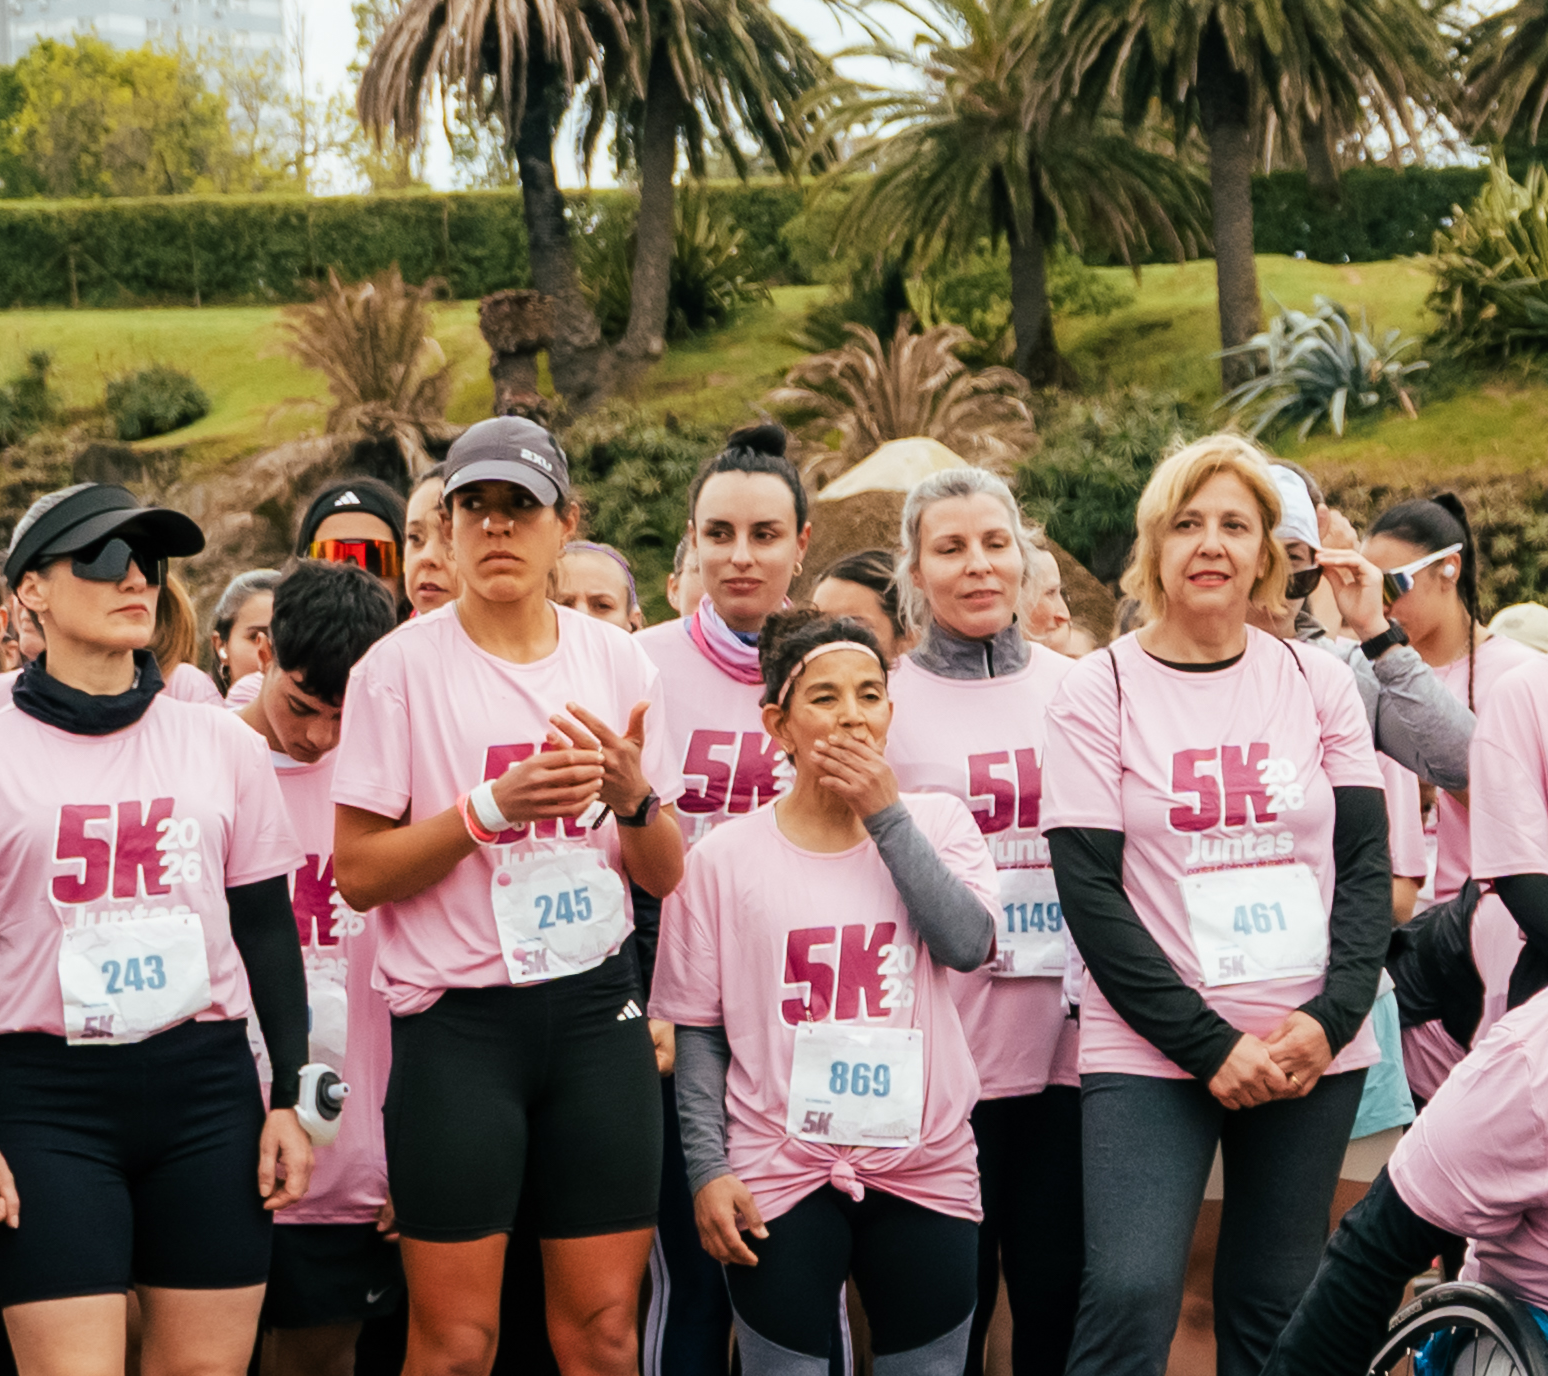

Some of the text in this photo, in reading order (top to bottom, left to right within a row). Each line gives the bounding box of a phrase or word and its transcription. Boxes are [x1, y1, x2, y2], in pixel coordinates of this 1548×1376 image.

[1165, 742, 1297, 836] 5K 20
[1265, 783, 1305, 813] 26
[48, 797, 200, 908] 5K 20
[1186, 831, 1294, 864] Juntas
[159, 851, 201, 885] 26
[535, 886, 593, 930] 245
[1003, 902, 1063, 933] 1149
[1233, 901, 1287, 936] 461
[102, 954, 167, 995] 243
[779, 922, 916, 1029] 5K 20
[1218, 955, 1246, 979] 5K
[880, 977, 916, 1008] 26
[829, 1061, 891, 1098] 869
